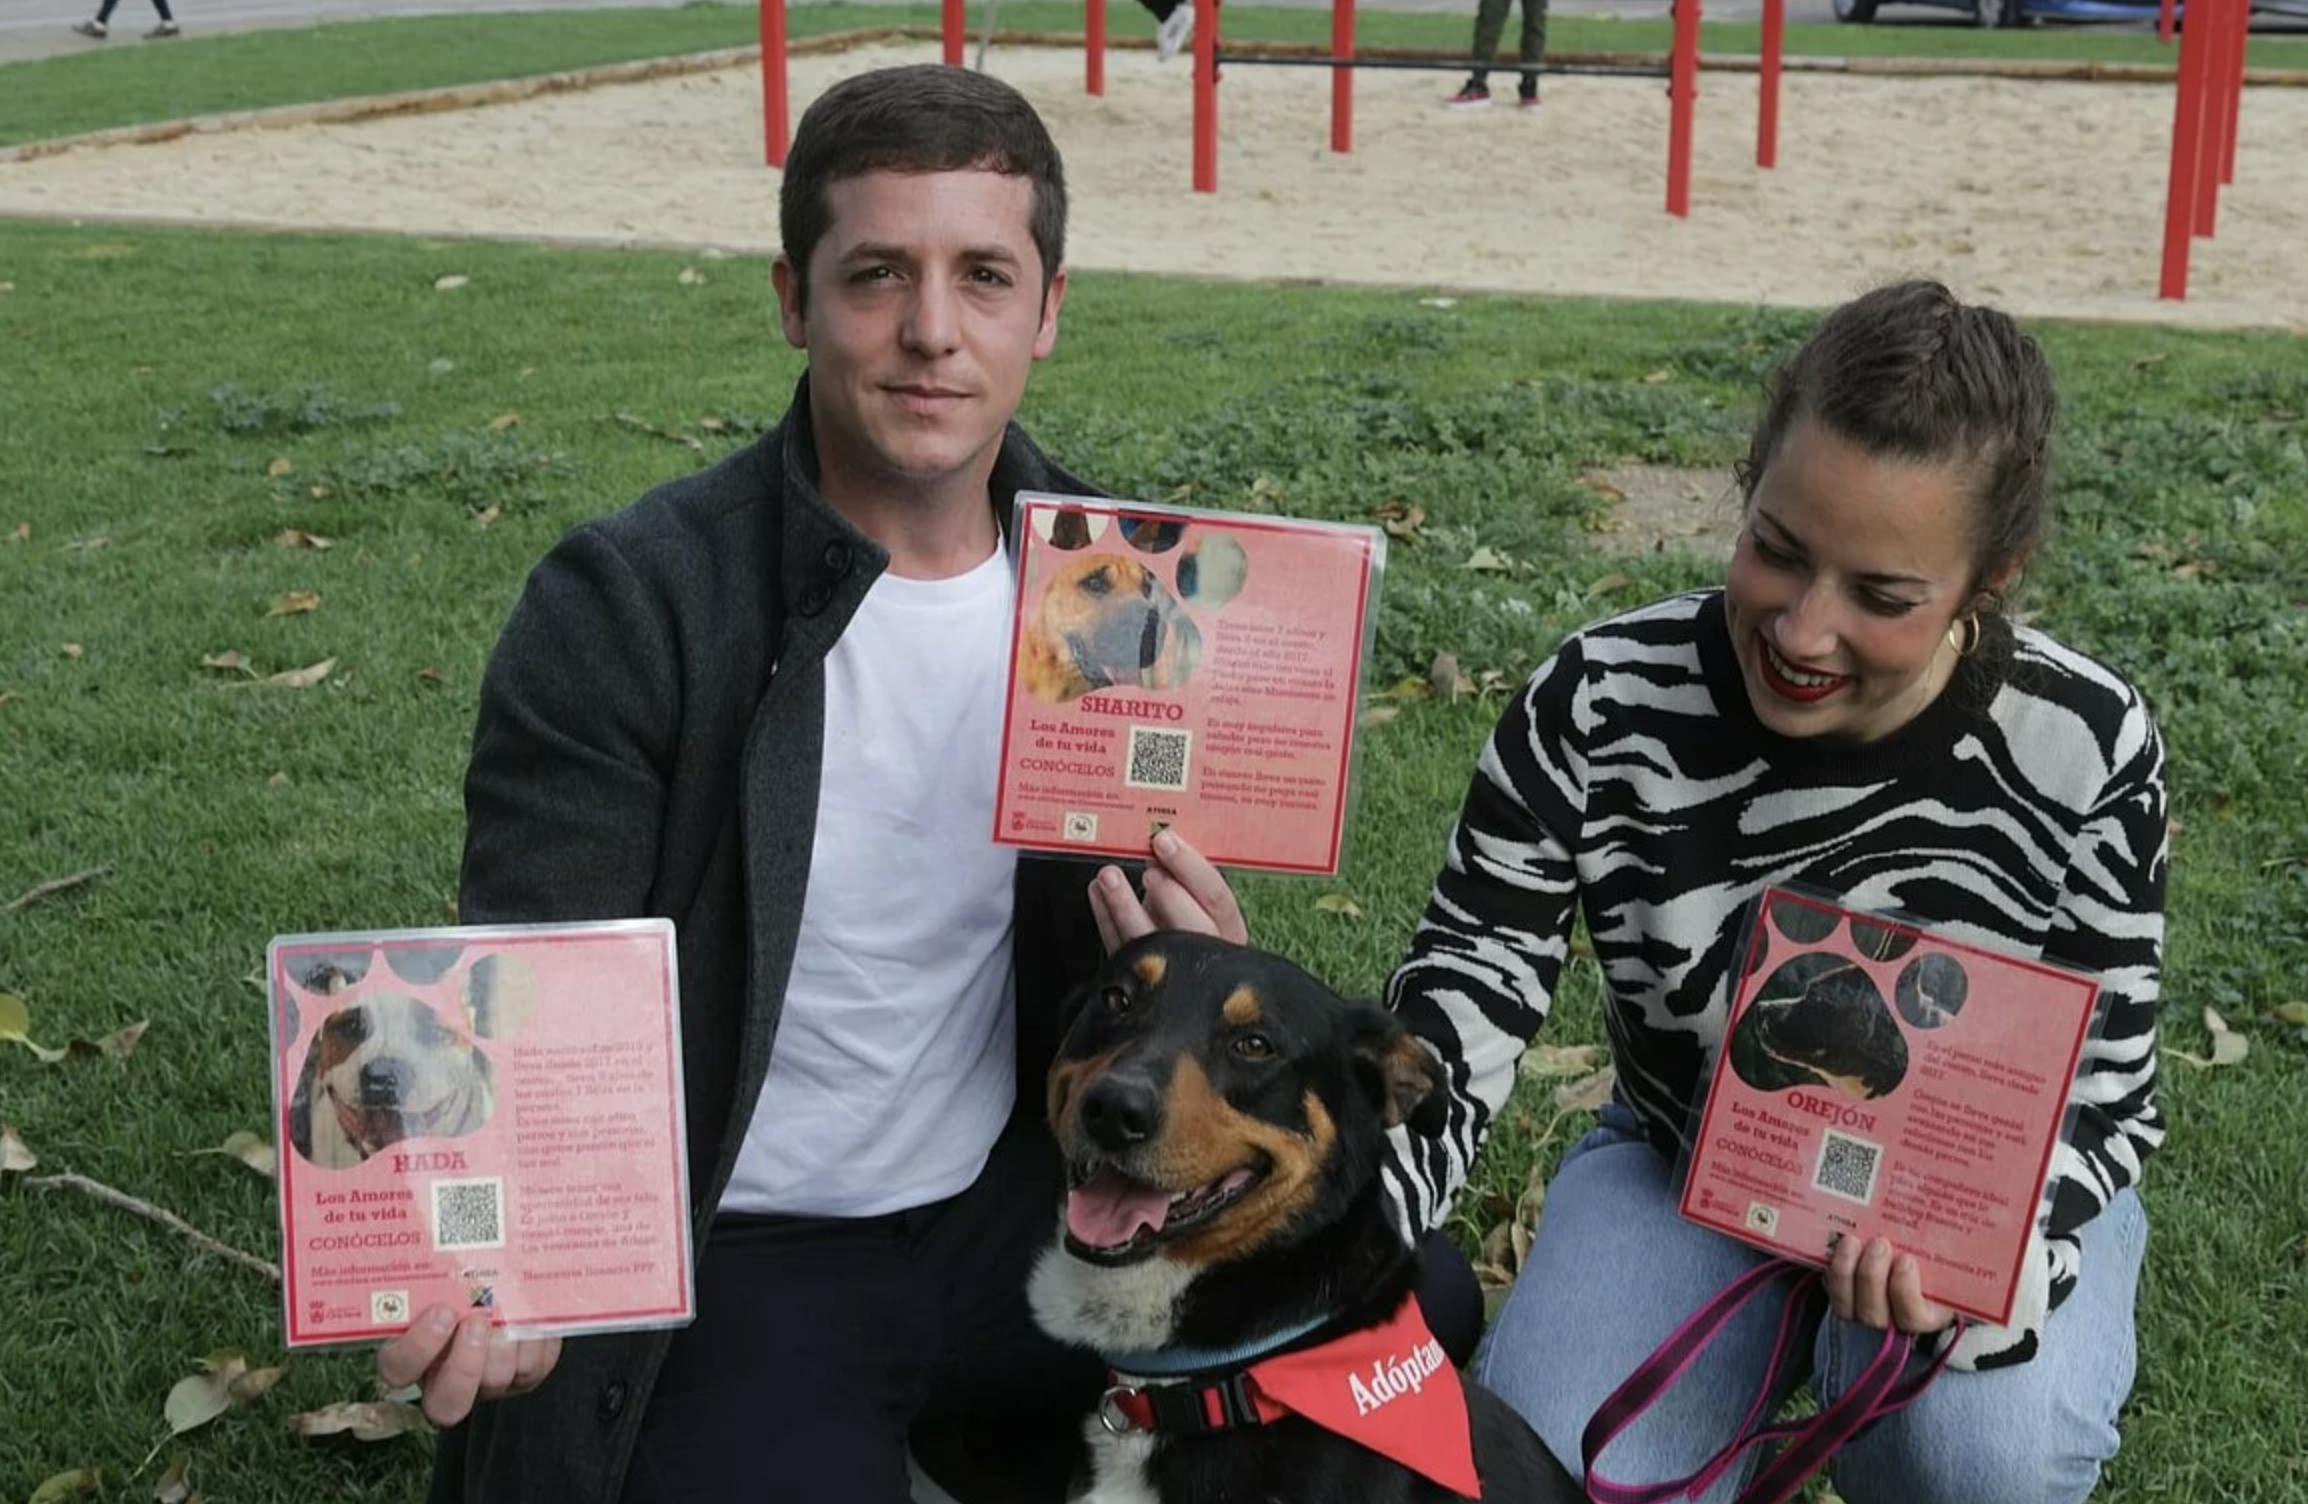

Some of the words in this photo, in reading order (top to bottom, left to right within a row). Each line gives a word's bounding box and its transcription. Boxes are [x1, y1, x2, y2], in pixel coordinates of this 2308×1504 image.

[1080, 696, 1184, 721] SHARITO
[1030, 719, 1055, 732] Los
[1059, 722, 1116, 738] Amores
[1035, 736, 1052, 749] de
[1056, 738, 1071, 750] tu
[1075, 740, 1106, 754] vida
[1019, 756, 1115, 777] CONÓCELOS
[1731, 1101, 1756, 1118] Los
[1757, 1109, 1810, 1136] Amores
[1786, 1089, 1877, 1136] OREJÓN
[1733, 1119, 1751, 1134] de
[1752, 1125, 1767, 1140] tu
[1769, 1131, 1800, 1150] vida
[392, 1150, 466, 1174] HADA
[1715, 1134, 1804, 1175] CONÓCELOS
[315, 1191, 344, 1206] Los
[349, 1187, 413, 1204] Amores
[324, 1209, 344, 1223] de
[349, 1208, 365, 1222] tu
[370, 1205, 406, 1221] vida
[309, 1228, 420, 1251] CONÓCELOS
